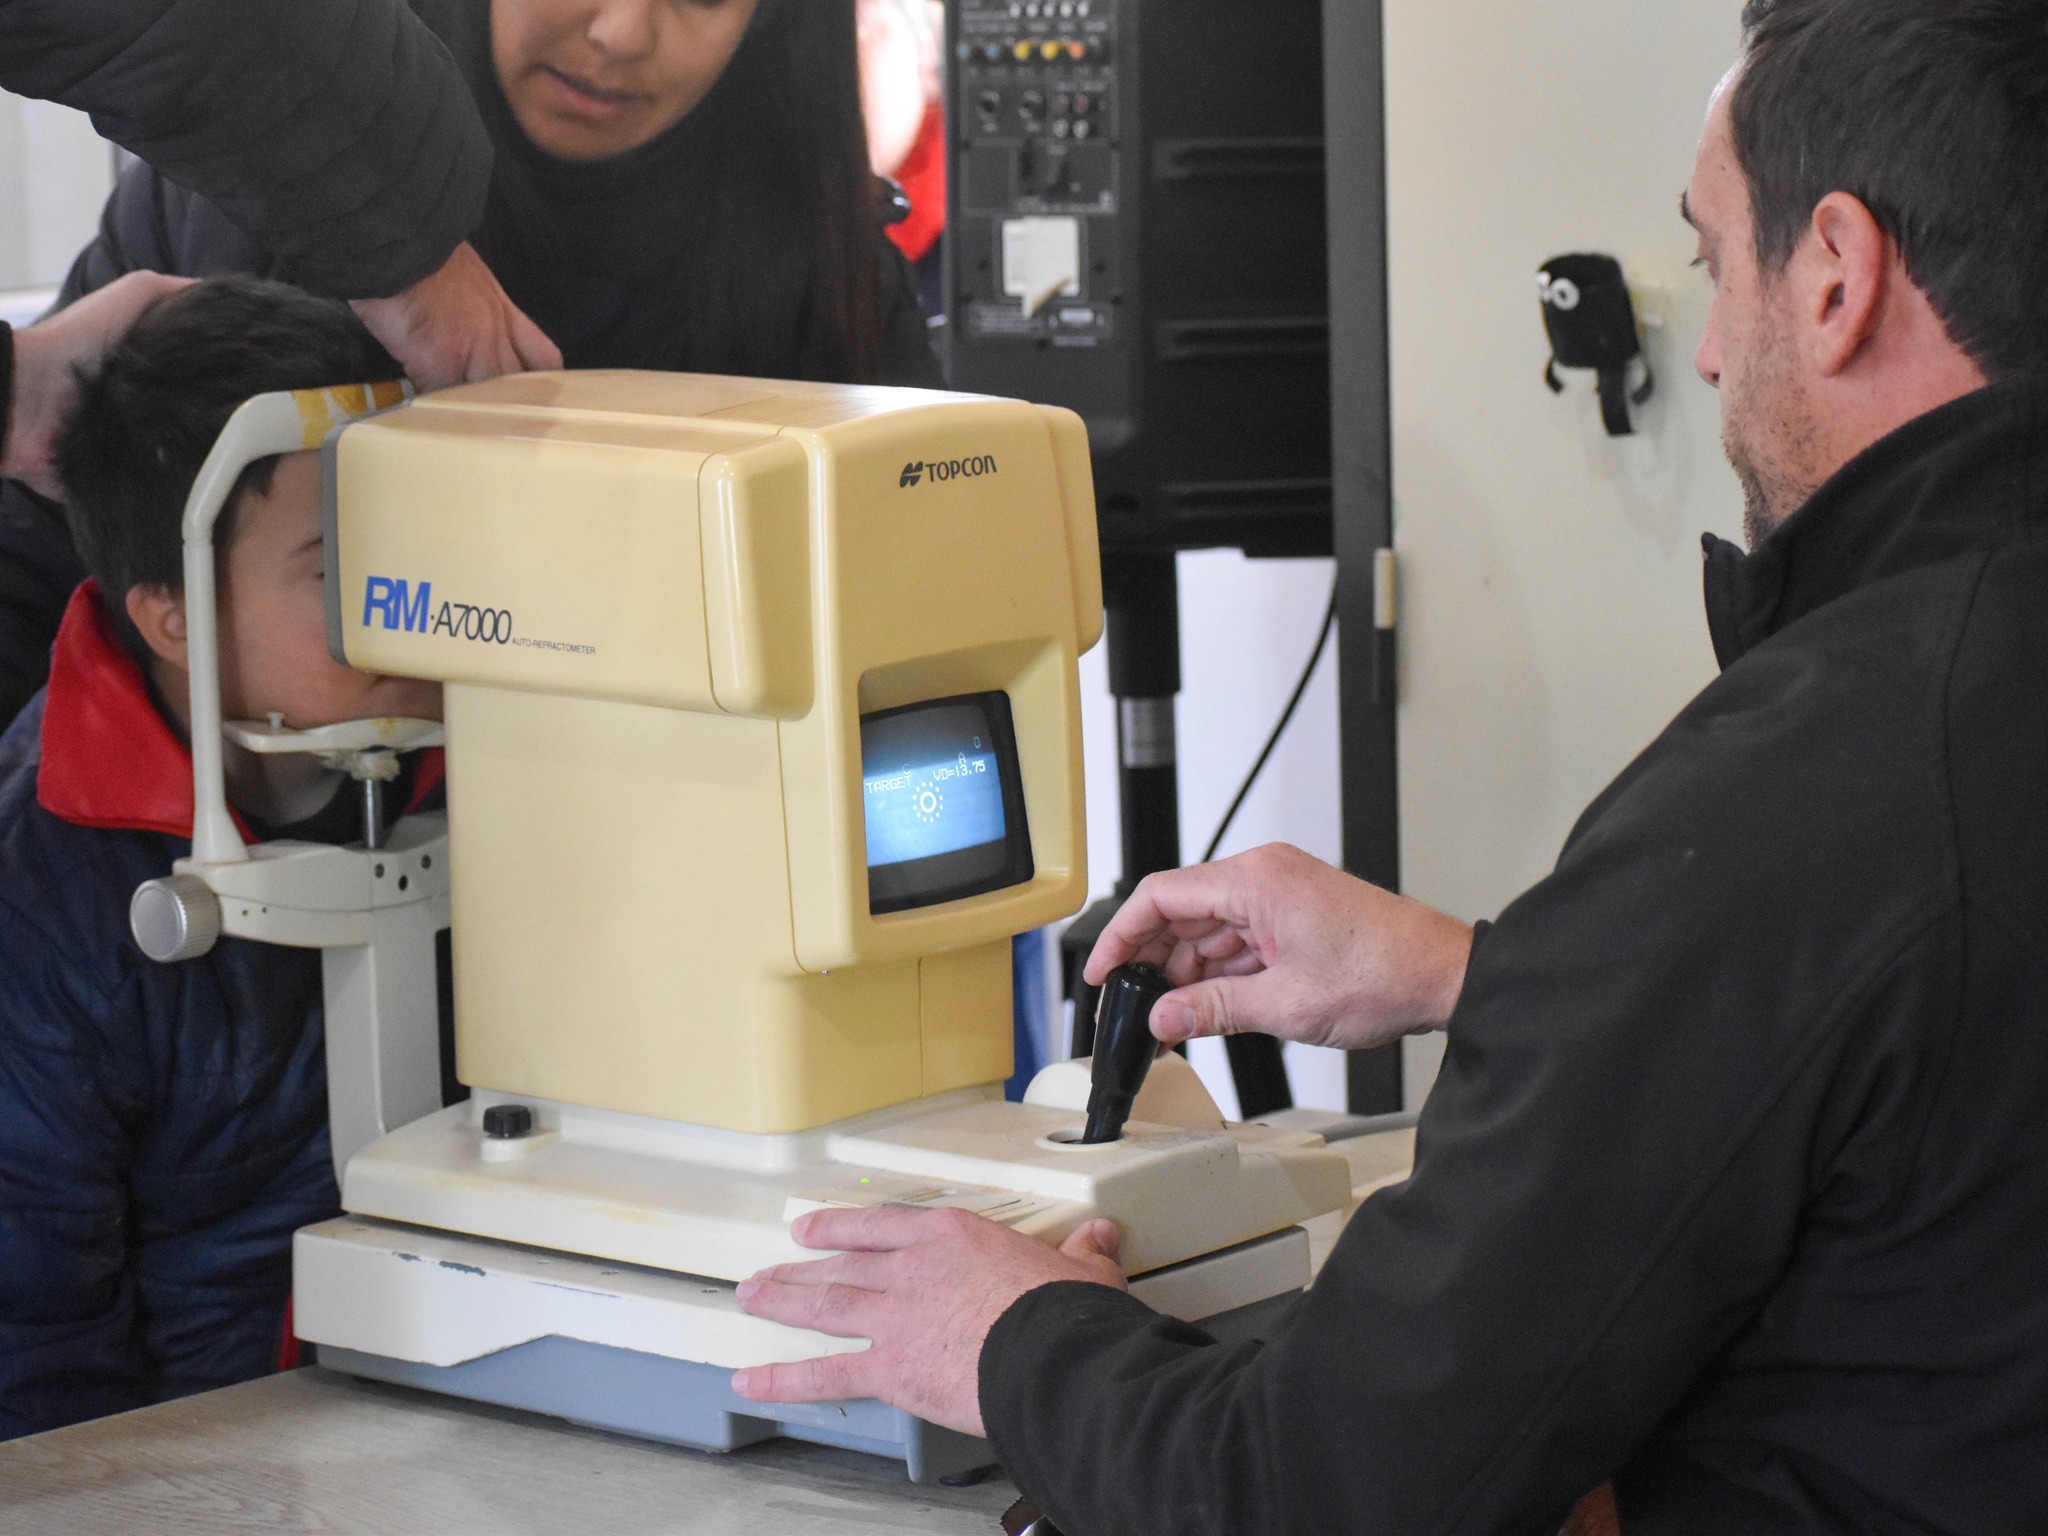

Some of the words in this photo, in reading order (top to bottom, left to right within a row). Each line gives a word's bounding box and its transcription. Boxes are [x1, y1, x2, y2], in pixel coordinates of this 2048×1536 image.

[925, 455, 997, 482] TOPCON
[512, 638, 596, 655] AUTO-REFRACTOMETER
[865, 775, 912, 794] TARGET
[933, 759, 986, 781] VD=13.75
